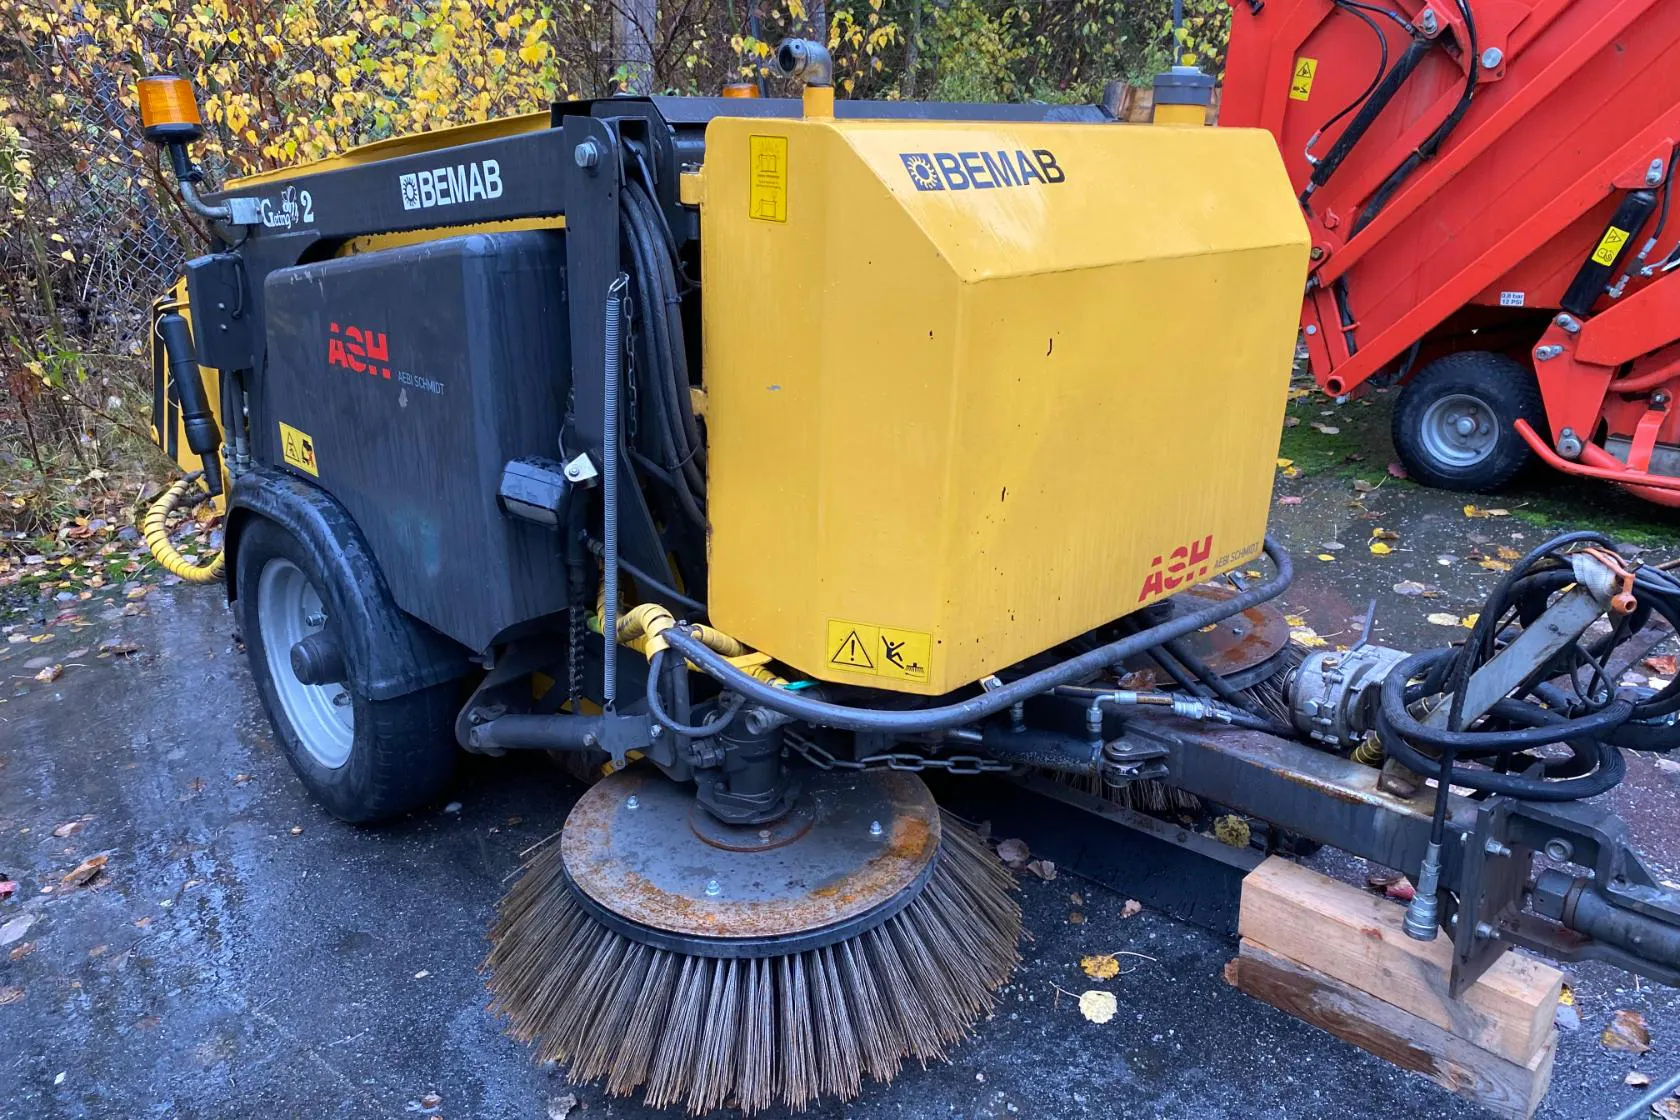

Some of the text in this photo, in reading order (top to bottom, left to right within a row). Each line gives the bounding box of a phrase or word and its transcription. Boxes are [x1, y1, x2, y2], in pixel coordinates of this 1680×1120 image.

[418, 159, 503, 208] BEMAB
[933, 150, 1065, 190] BEMAB
[300, 190, 314, 223] 2
[328, 322, 391, 379] ASH
[398, 371, 445, 395] AEBI SCHMIDT
[1137, 534, 1213, 603] ASH
[1215, 542, 1259, 568] AEBI SCHMIDT
